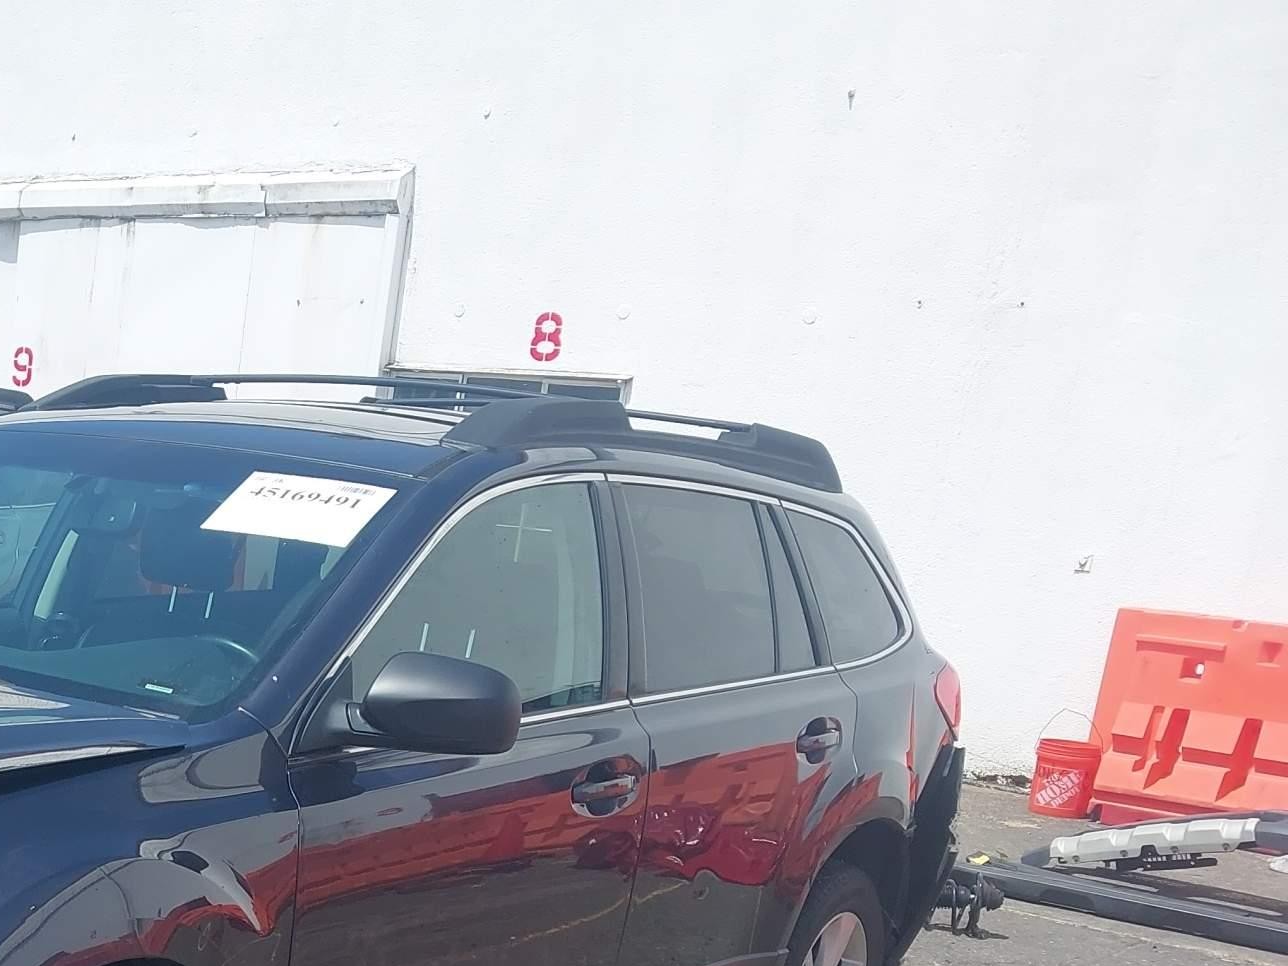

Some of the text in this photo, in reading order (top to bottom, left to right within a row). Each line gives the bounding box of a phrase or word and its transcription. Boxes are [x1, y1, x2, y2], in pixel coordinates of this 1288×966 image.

[529, 311, 563, 362] 8
[12, 345, 34, 388] 9
[249, 486, 362, 509] 45169491
